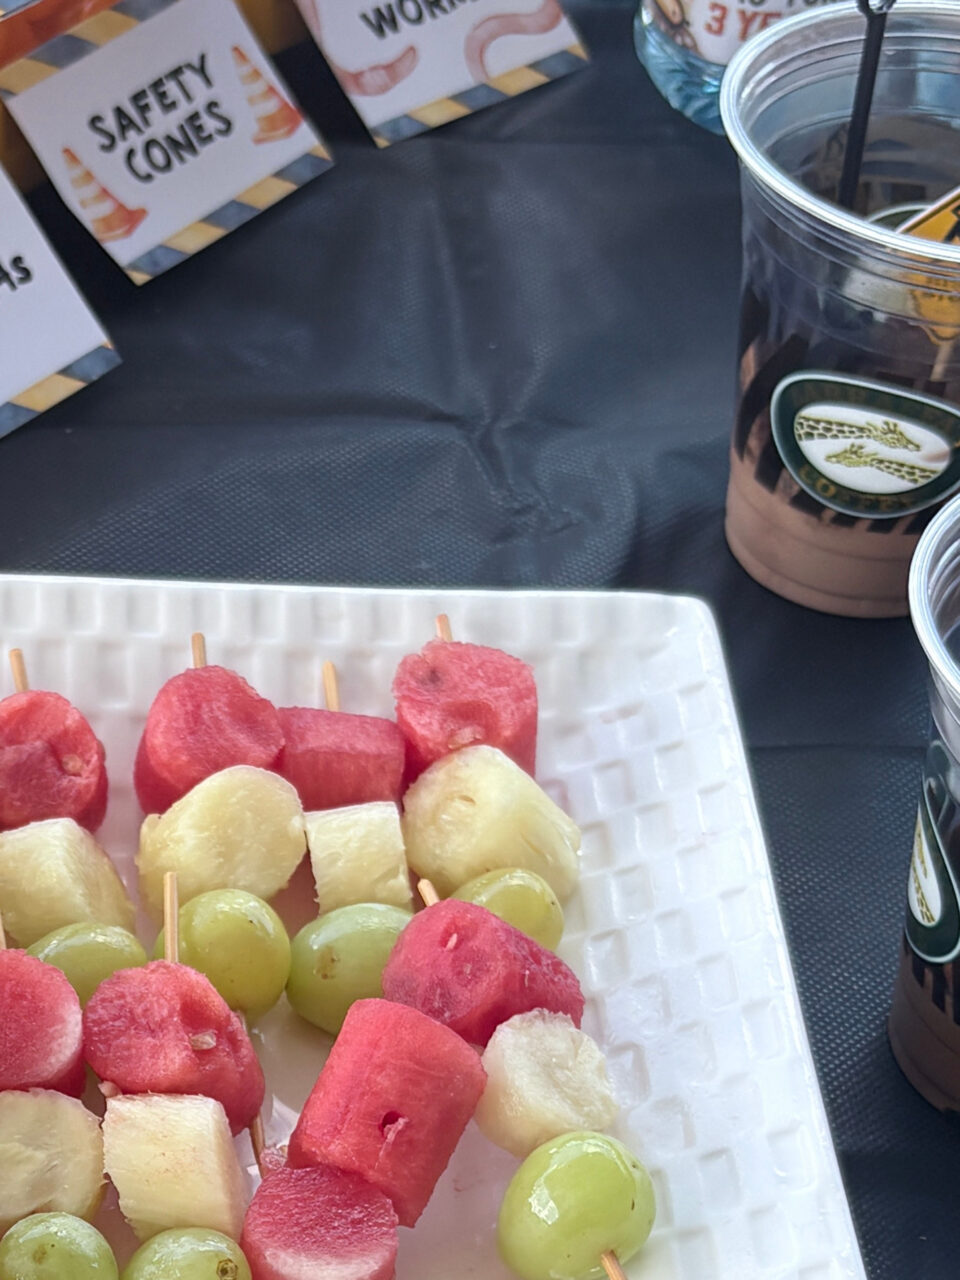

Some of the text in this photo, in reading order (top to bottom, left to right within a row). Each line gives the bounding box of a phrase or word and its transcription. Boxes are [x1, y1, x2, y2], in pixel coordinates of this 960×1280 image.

[704, 2, 728, 37] 3
[88, 53, 214, 152] SAFETY
[125, 100, 232, 183] CONES
